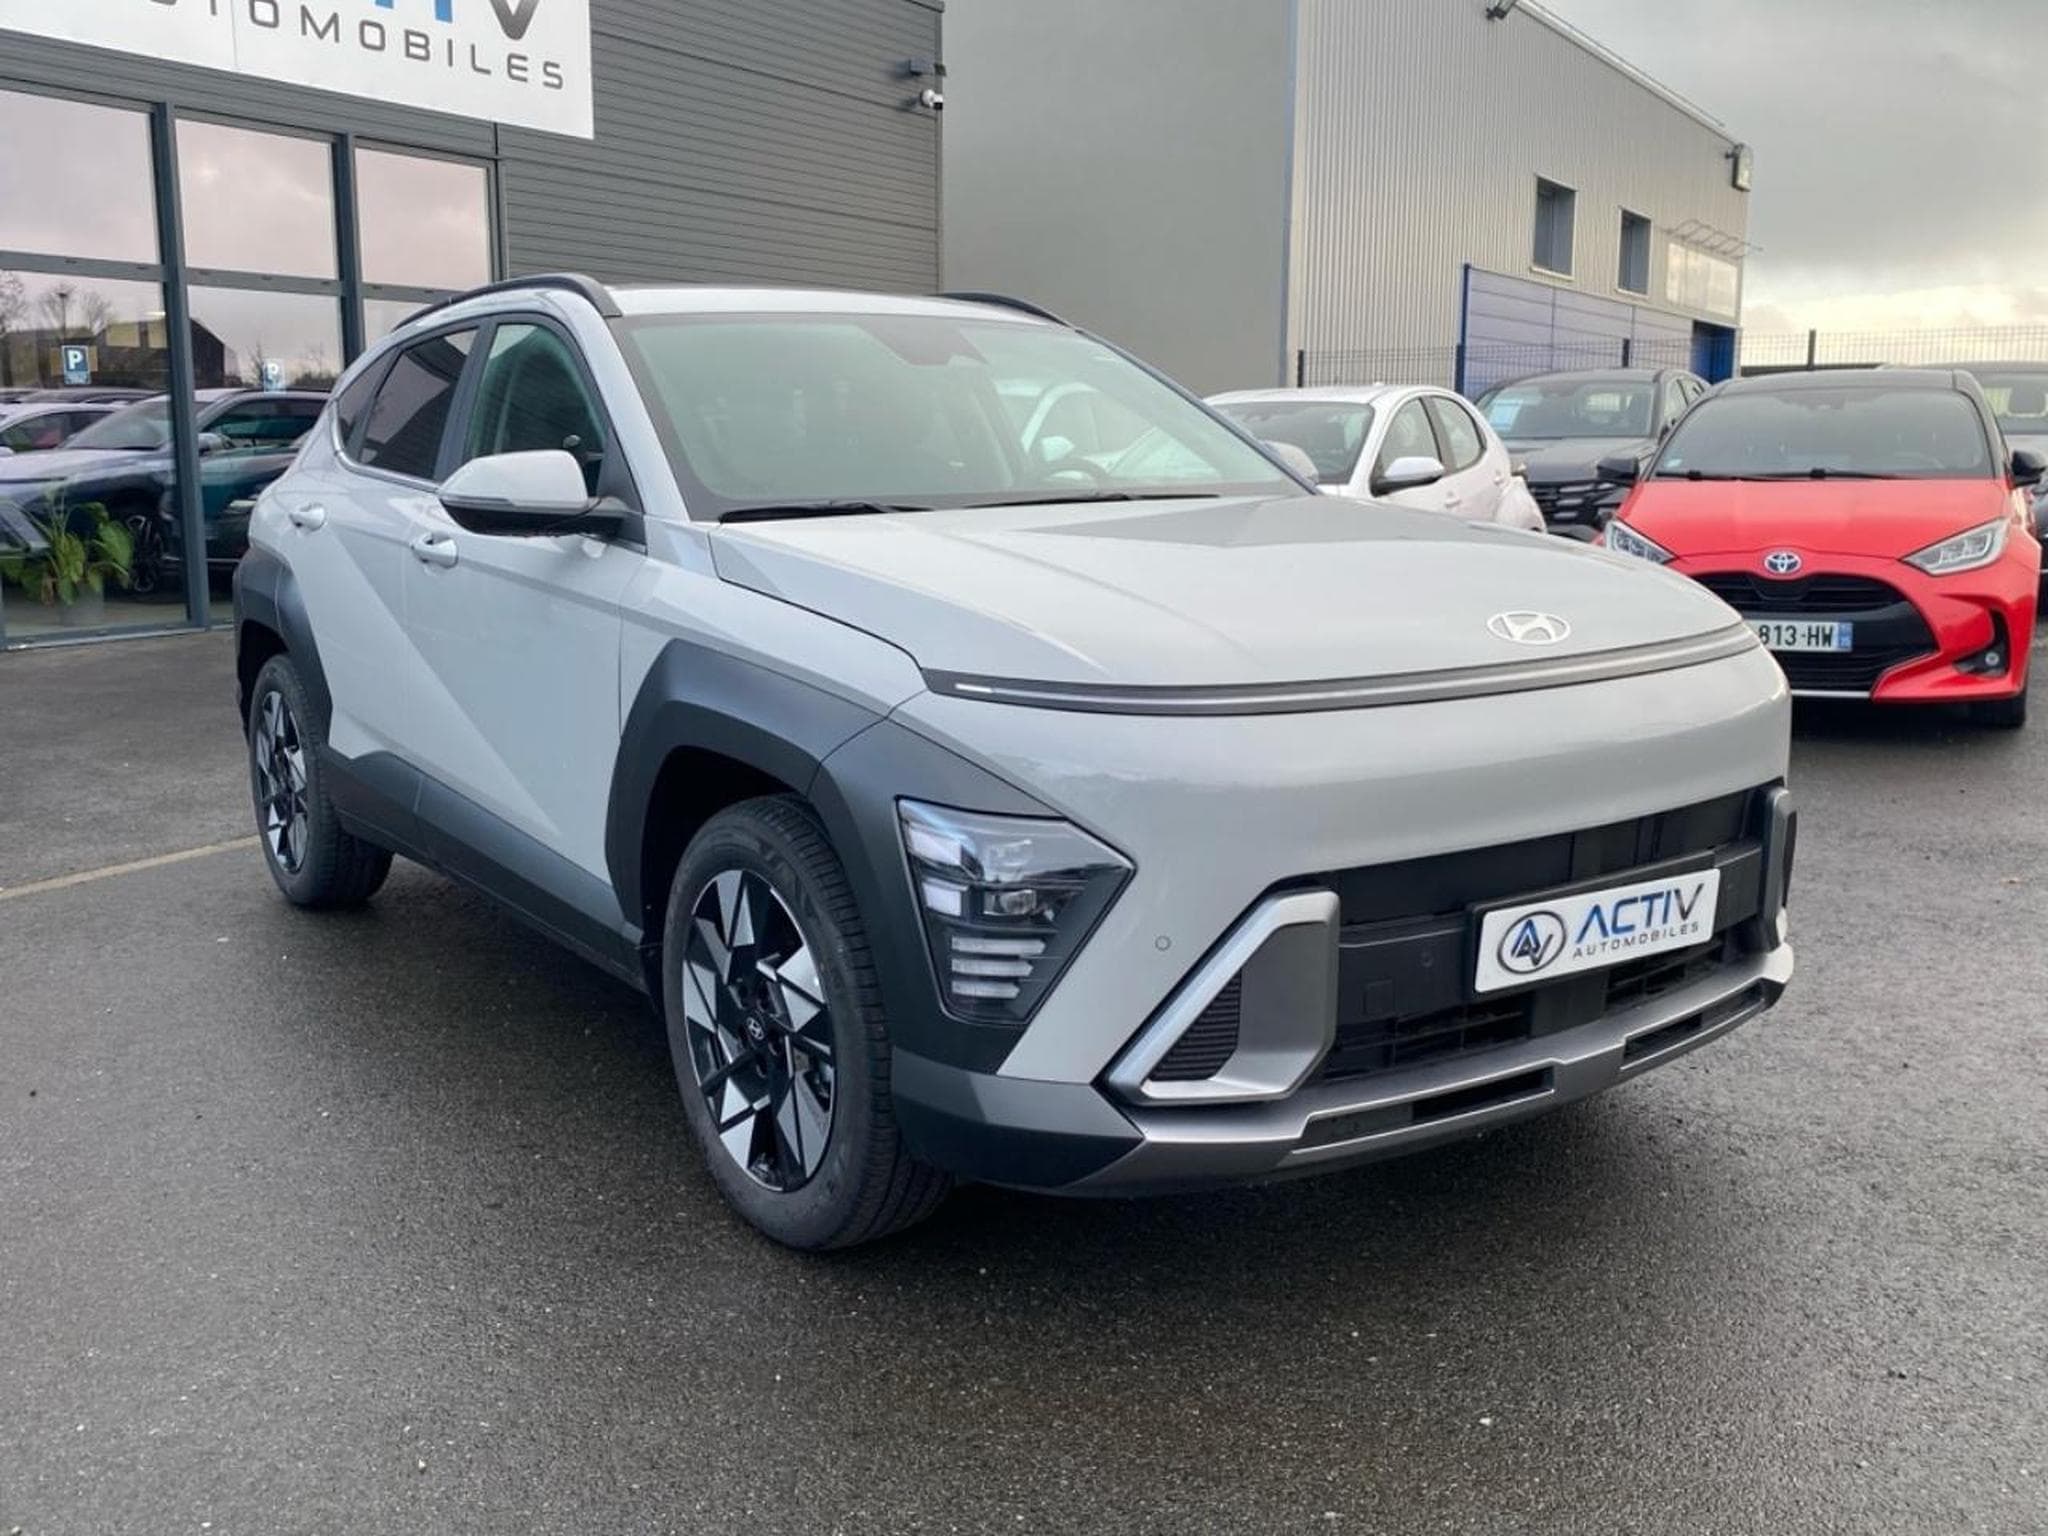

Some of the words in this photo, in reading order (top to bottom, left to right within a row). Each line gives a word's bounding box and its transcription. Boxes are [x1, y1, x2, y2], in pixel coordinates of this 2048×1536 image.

[151, 0, 563, 89] OMOBILES
[68, 350, 83, 370] P
[267, 363, 279, 379] P
[1575, 883, 1704, 944] ACTIV
[1573, 922, 1699, 958] AUTOMOBILES
